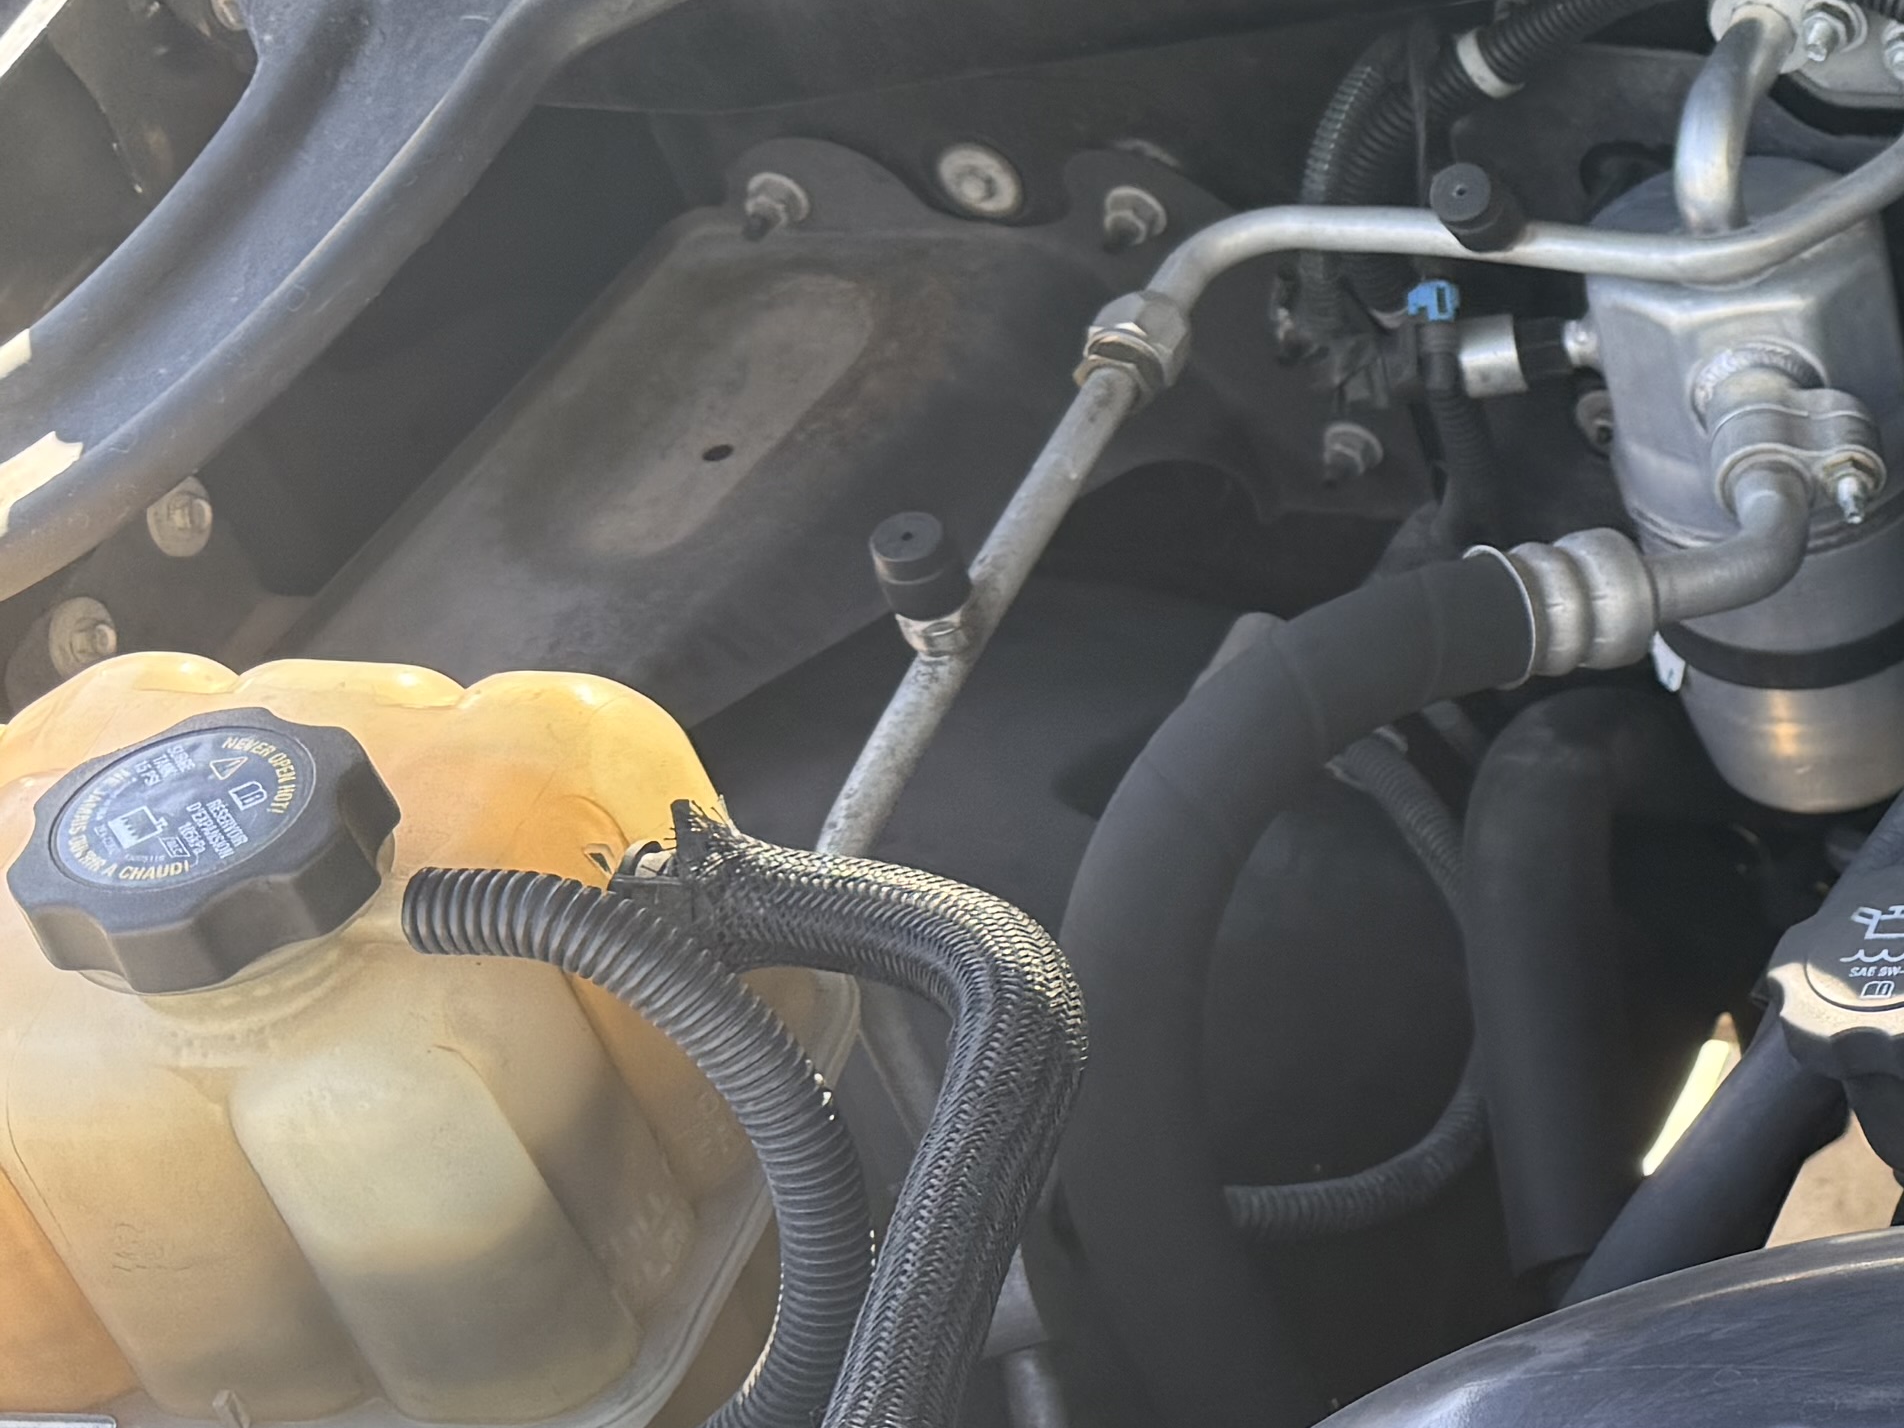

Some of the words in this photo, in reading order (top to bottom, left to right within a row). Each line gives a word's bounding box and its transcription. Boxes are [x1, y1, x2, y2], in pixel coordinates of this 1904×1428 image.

[221, 736, 277, 758] NEVER
[268, 753, 297, 784] OPEN
[68, 785, 110, 837] JAMAIS
[267, 783, 297, 814] HOT!
[67, 837, 110, 871] OUVRIR
[118, 859, 191, 881] CHAUD!
[1848, 966, 1878, 978] SAE
